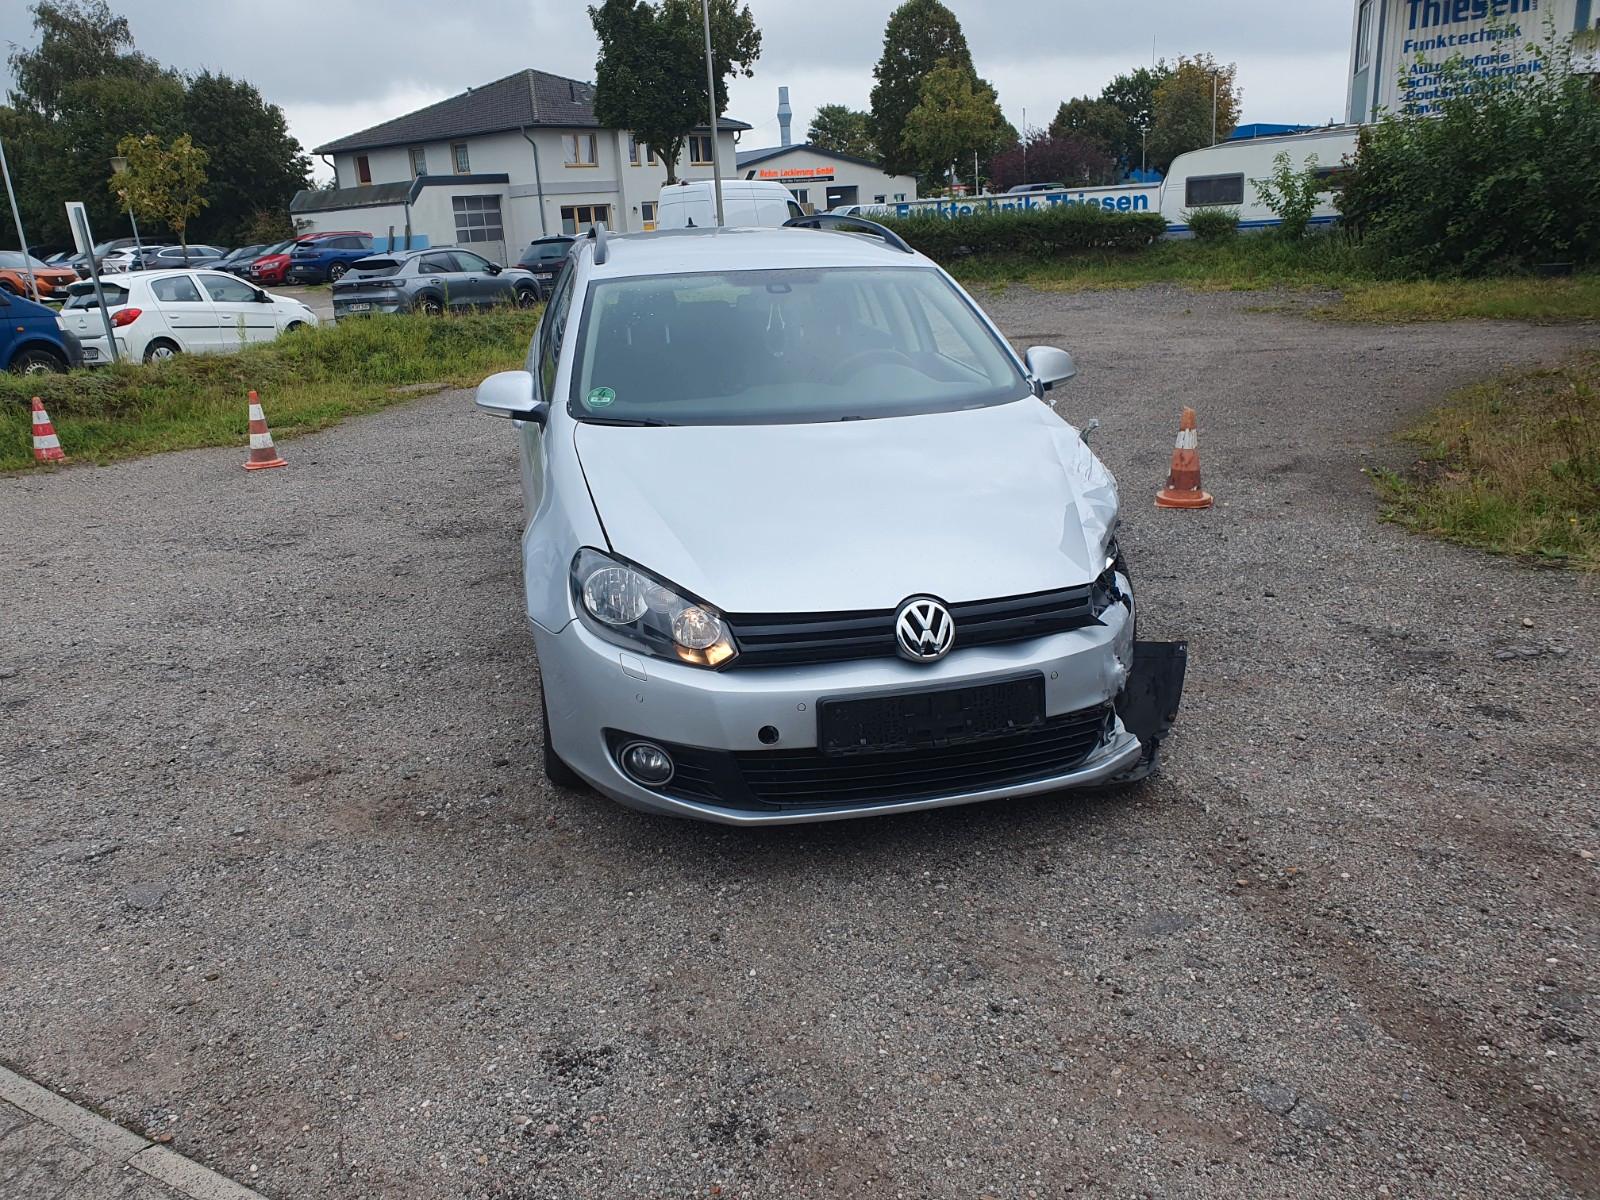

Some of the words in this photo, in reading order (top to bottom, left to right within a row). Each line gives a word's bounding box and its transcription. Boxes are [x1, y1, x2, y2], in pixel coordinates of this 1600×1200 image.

[781, 168, 814, 177] Lackierung
[815, 167, 834, 175] GmbH
[1046, 191, 1148, 212] Thiesen
[897, 599, 953, 657] VW
